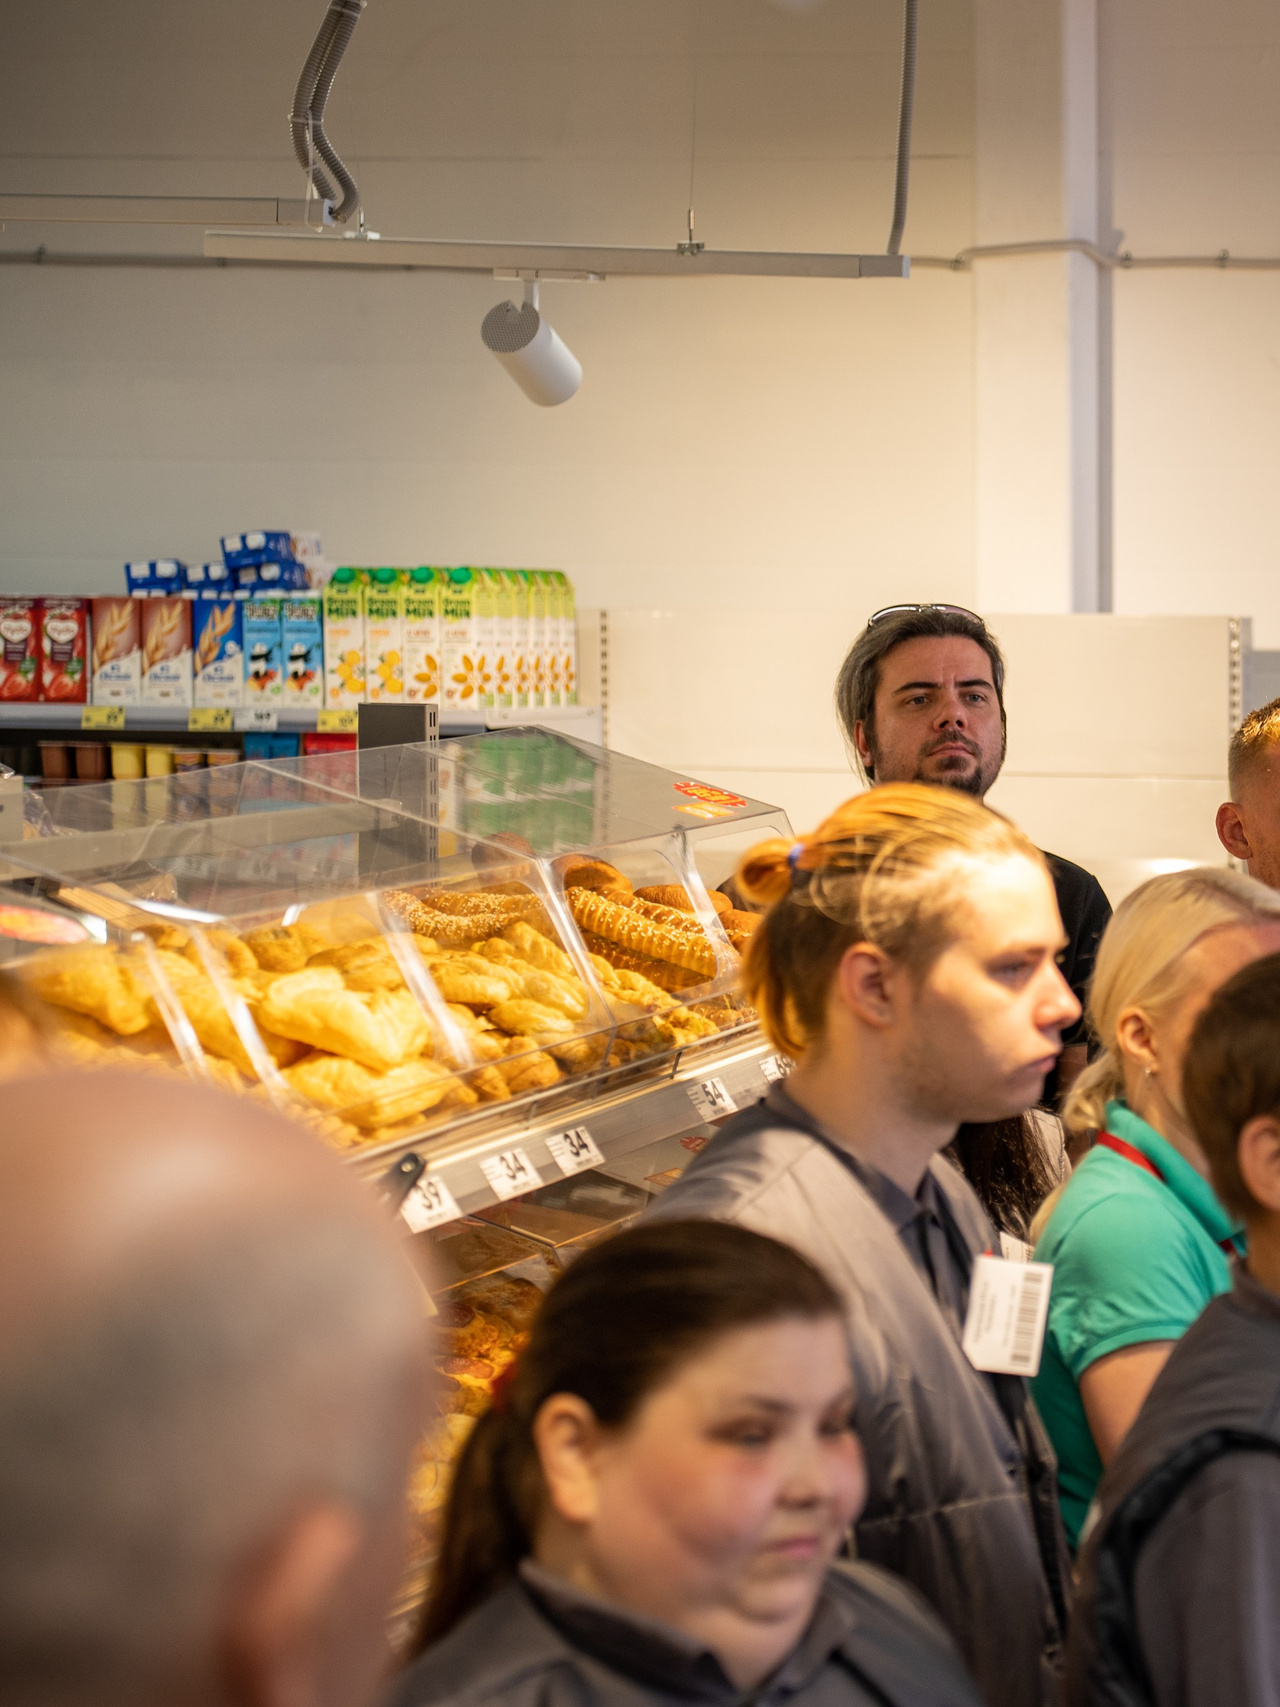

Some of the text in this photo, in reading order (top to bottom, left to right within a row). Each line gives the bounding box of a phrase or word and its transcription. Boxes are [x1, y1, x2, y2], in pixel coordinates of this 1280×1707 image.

[327, 598, 358, 607] Green
[368, 598, 397, 607] Green
[404, 598, 434, 607] Green
[443, 598, 471, 607] Green
[327, 607, 358, 619] Milk
[368, 607, 397, 619] Milk
[404, 607, 434, 619] Milk
[443, 607, 471, 619] Milk
[700, 1080, 726, 1107] 54
[563, 1130, 591, 1157] 34
[499, 1152, 528, 1181] 34
[415, 1180, 442, 1210] 39
